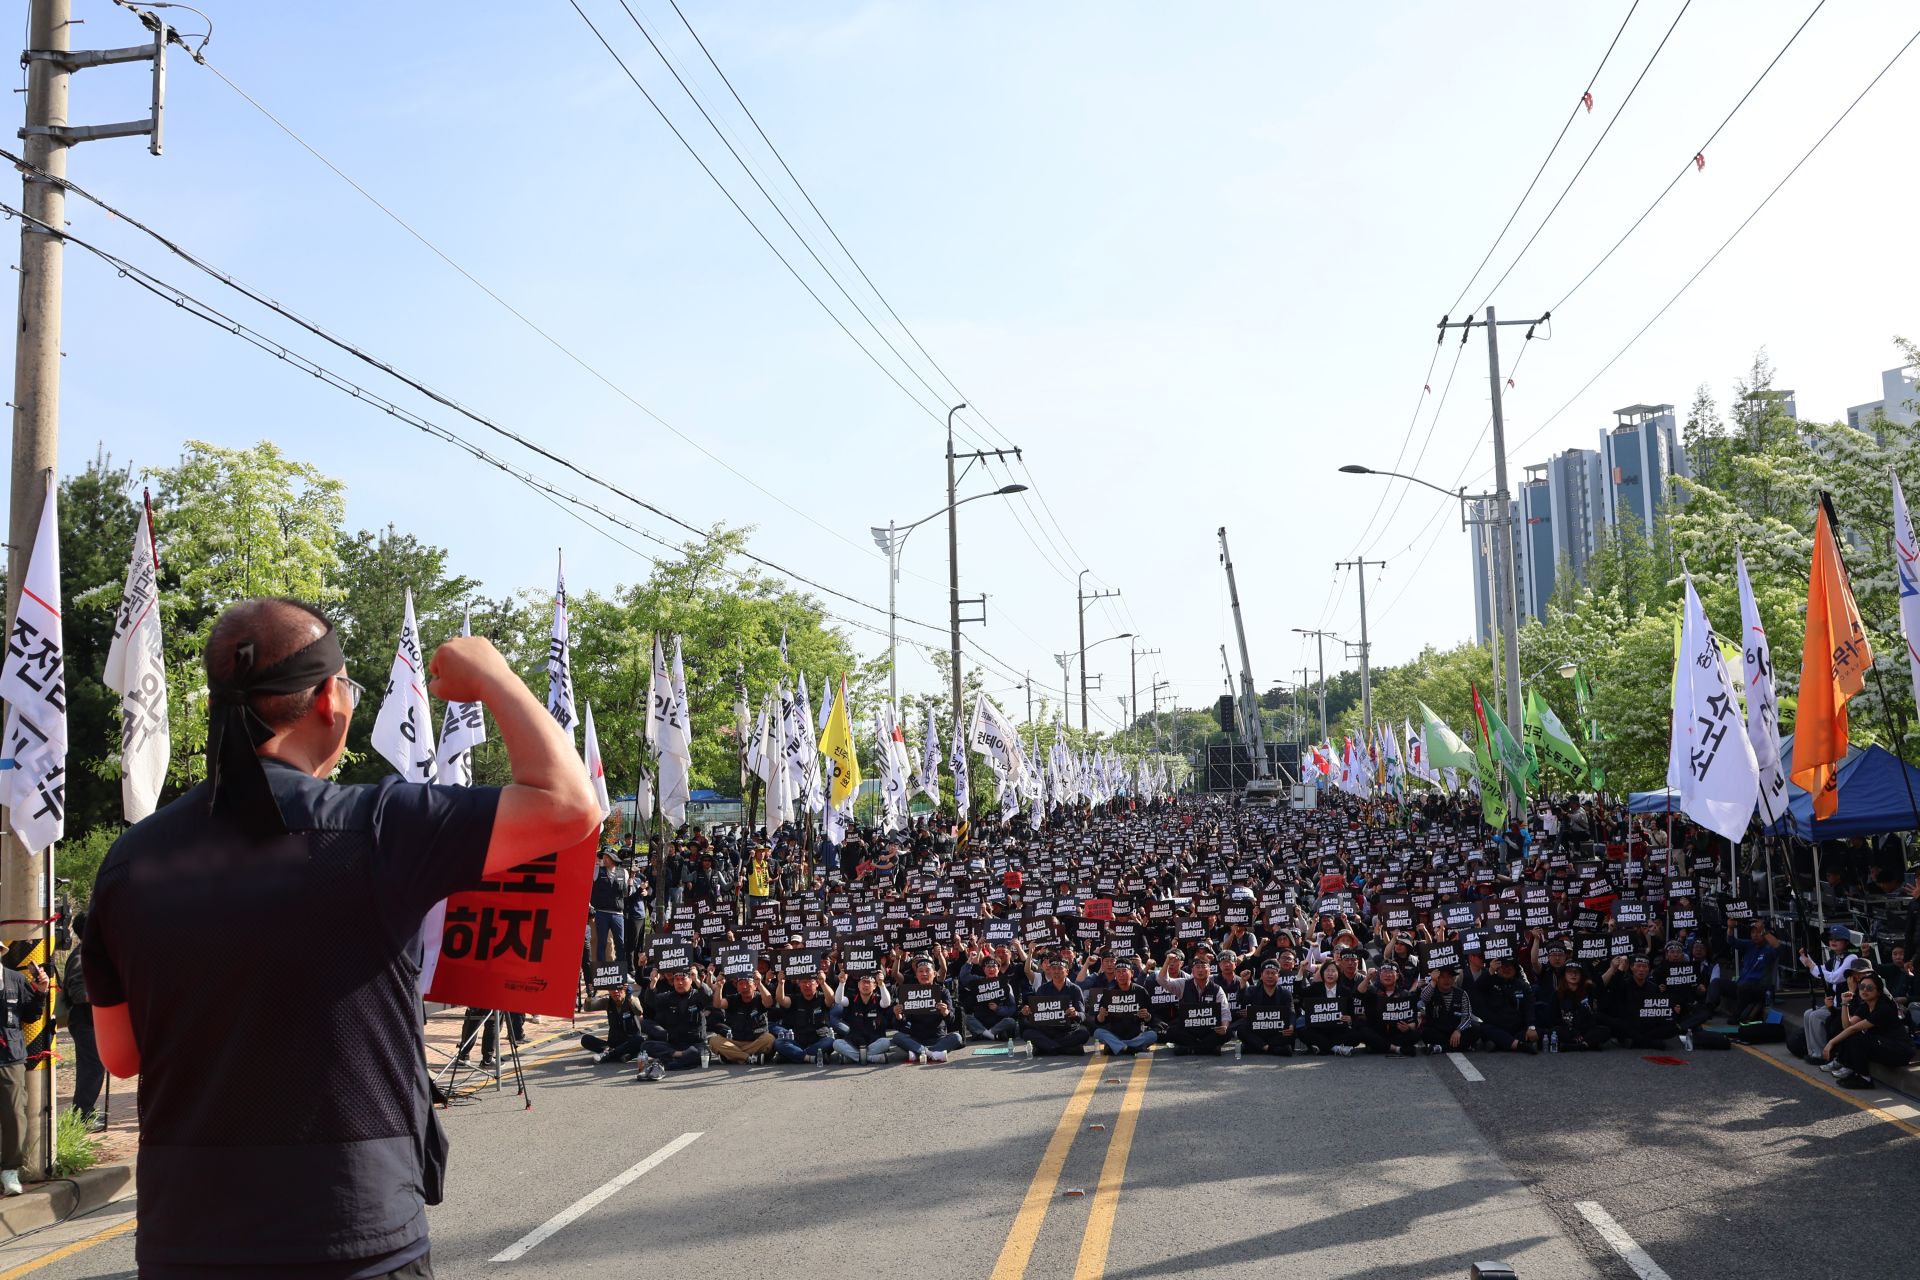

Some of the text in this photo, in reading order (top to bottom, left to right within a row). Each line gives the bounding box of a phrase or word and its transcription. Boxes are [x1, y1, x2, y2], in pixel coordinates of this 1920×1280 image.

[444, 906, 552, 962] 하자
[1486, 938, 1508, 949] 열사의
[1583, 939, 1605, 948] 열사의
[662, 948, 684, 959] 열사의
[1430, 946, 1453, 958] 열사의
[1612, 945, 1633, 955] 원이다
[728, 954, 750, 964] 열사의
[790, 955, 812, 965] 열사의
[851, 951, 873, 960] 열사의
[597, 966, 618, 976] 열사의
[1670, 966, 1692, 975] 열사의
[978, 981, 1000, 992] 열사의
[908, 990, 931, 999] 열사의
[1112, 994, 1135, 1003] 열사의
[1038, 1001, 1060, 1011] 열사의
[1314, 1002, 1338, 1012] 열사의
[1387, 1001, 1410, 1011] 열사의
[1644, 999, 1669, 1007] 열사의
[1188, 1008, 1212, 1017] 열사의
[1256, 1011, 1280, 1020] 열사의
